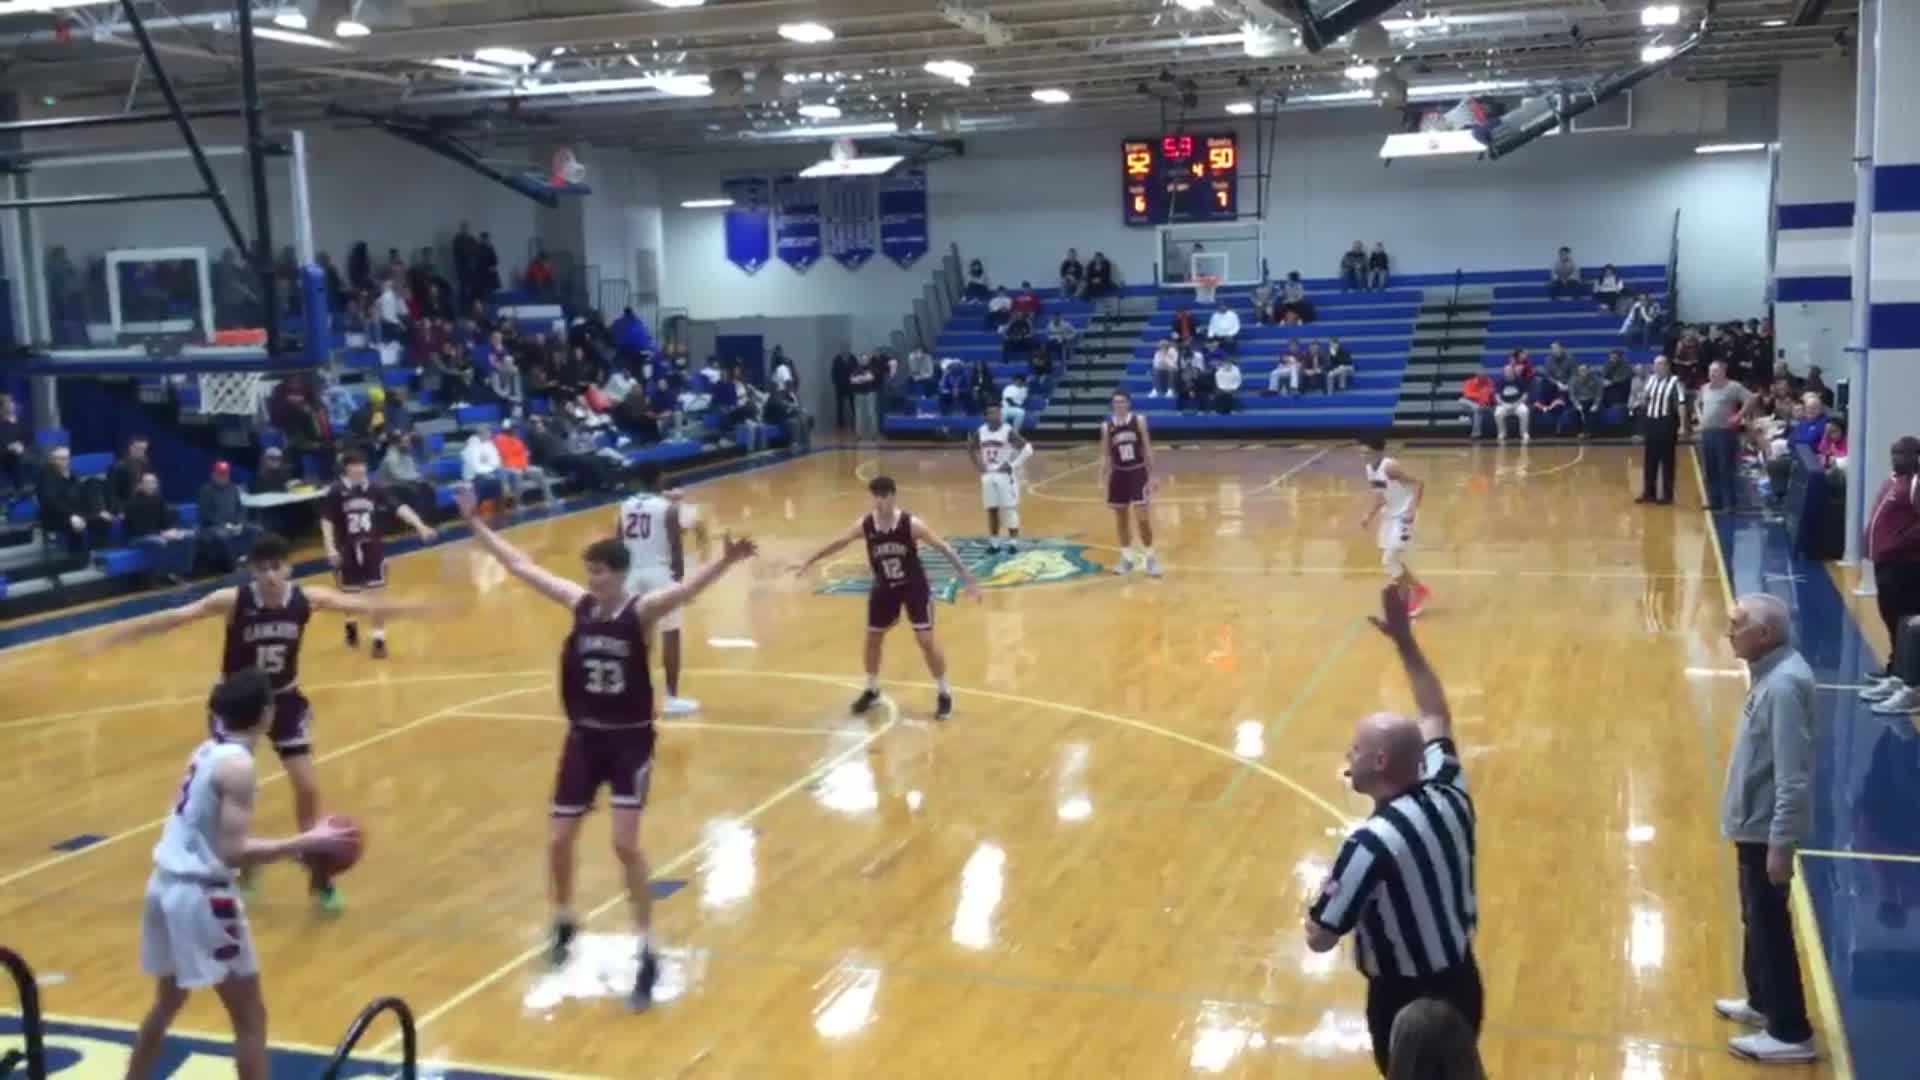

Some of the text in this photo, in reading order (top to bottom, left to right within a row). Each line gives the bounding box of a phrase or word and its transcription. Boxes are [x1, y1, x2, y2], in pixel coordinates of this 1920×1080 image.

[1127, 152, 1151, 174] 52
[1209, 147, 1234, 169] 50
[1192, 163, 1204, 177] 4
[1134, 195, 1146, 212] 6
[1216, 191, 1227, 207] 7
[348, 513, 371, 533] 24
[625, 512, 651, 539] 20
[881, 558, 904, 579] 12
[256, 644, 288, 672] 15
[583, 659, 624, 693] 33
